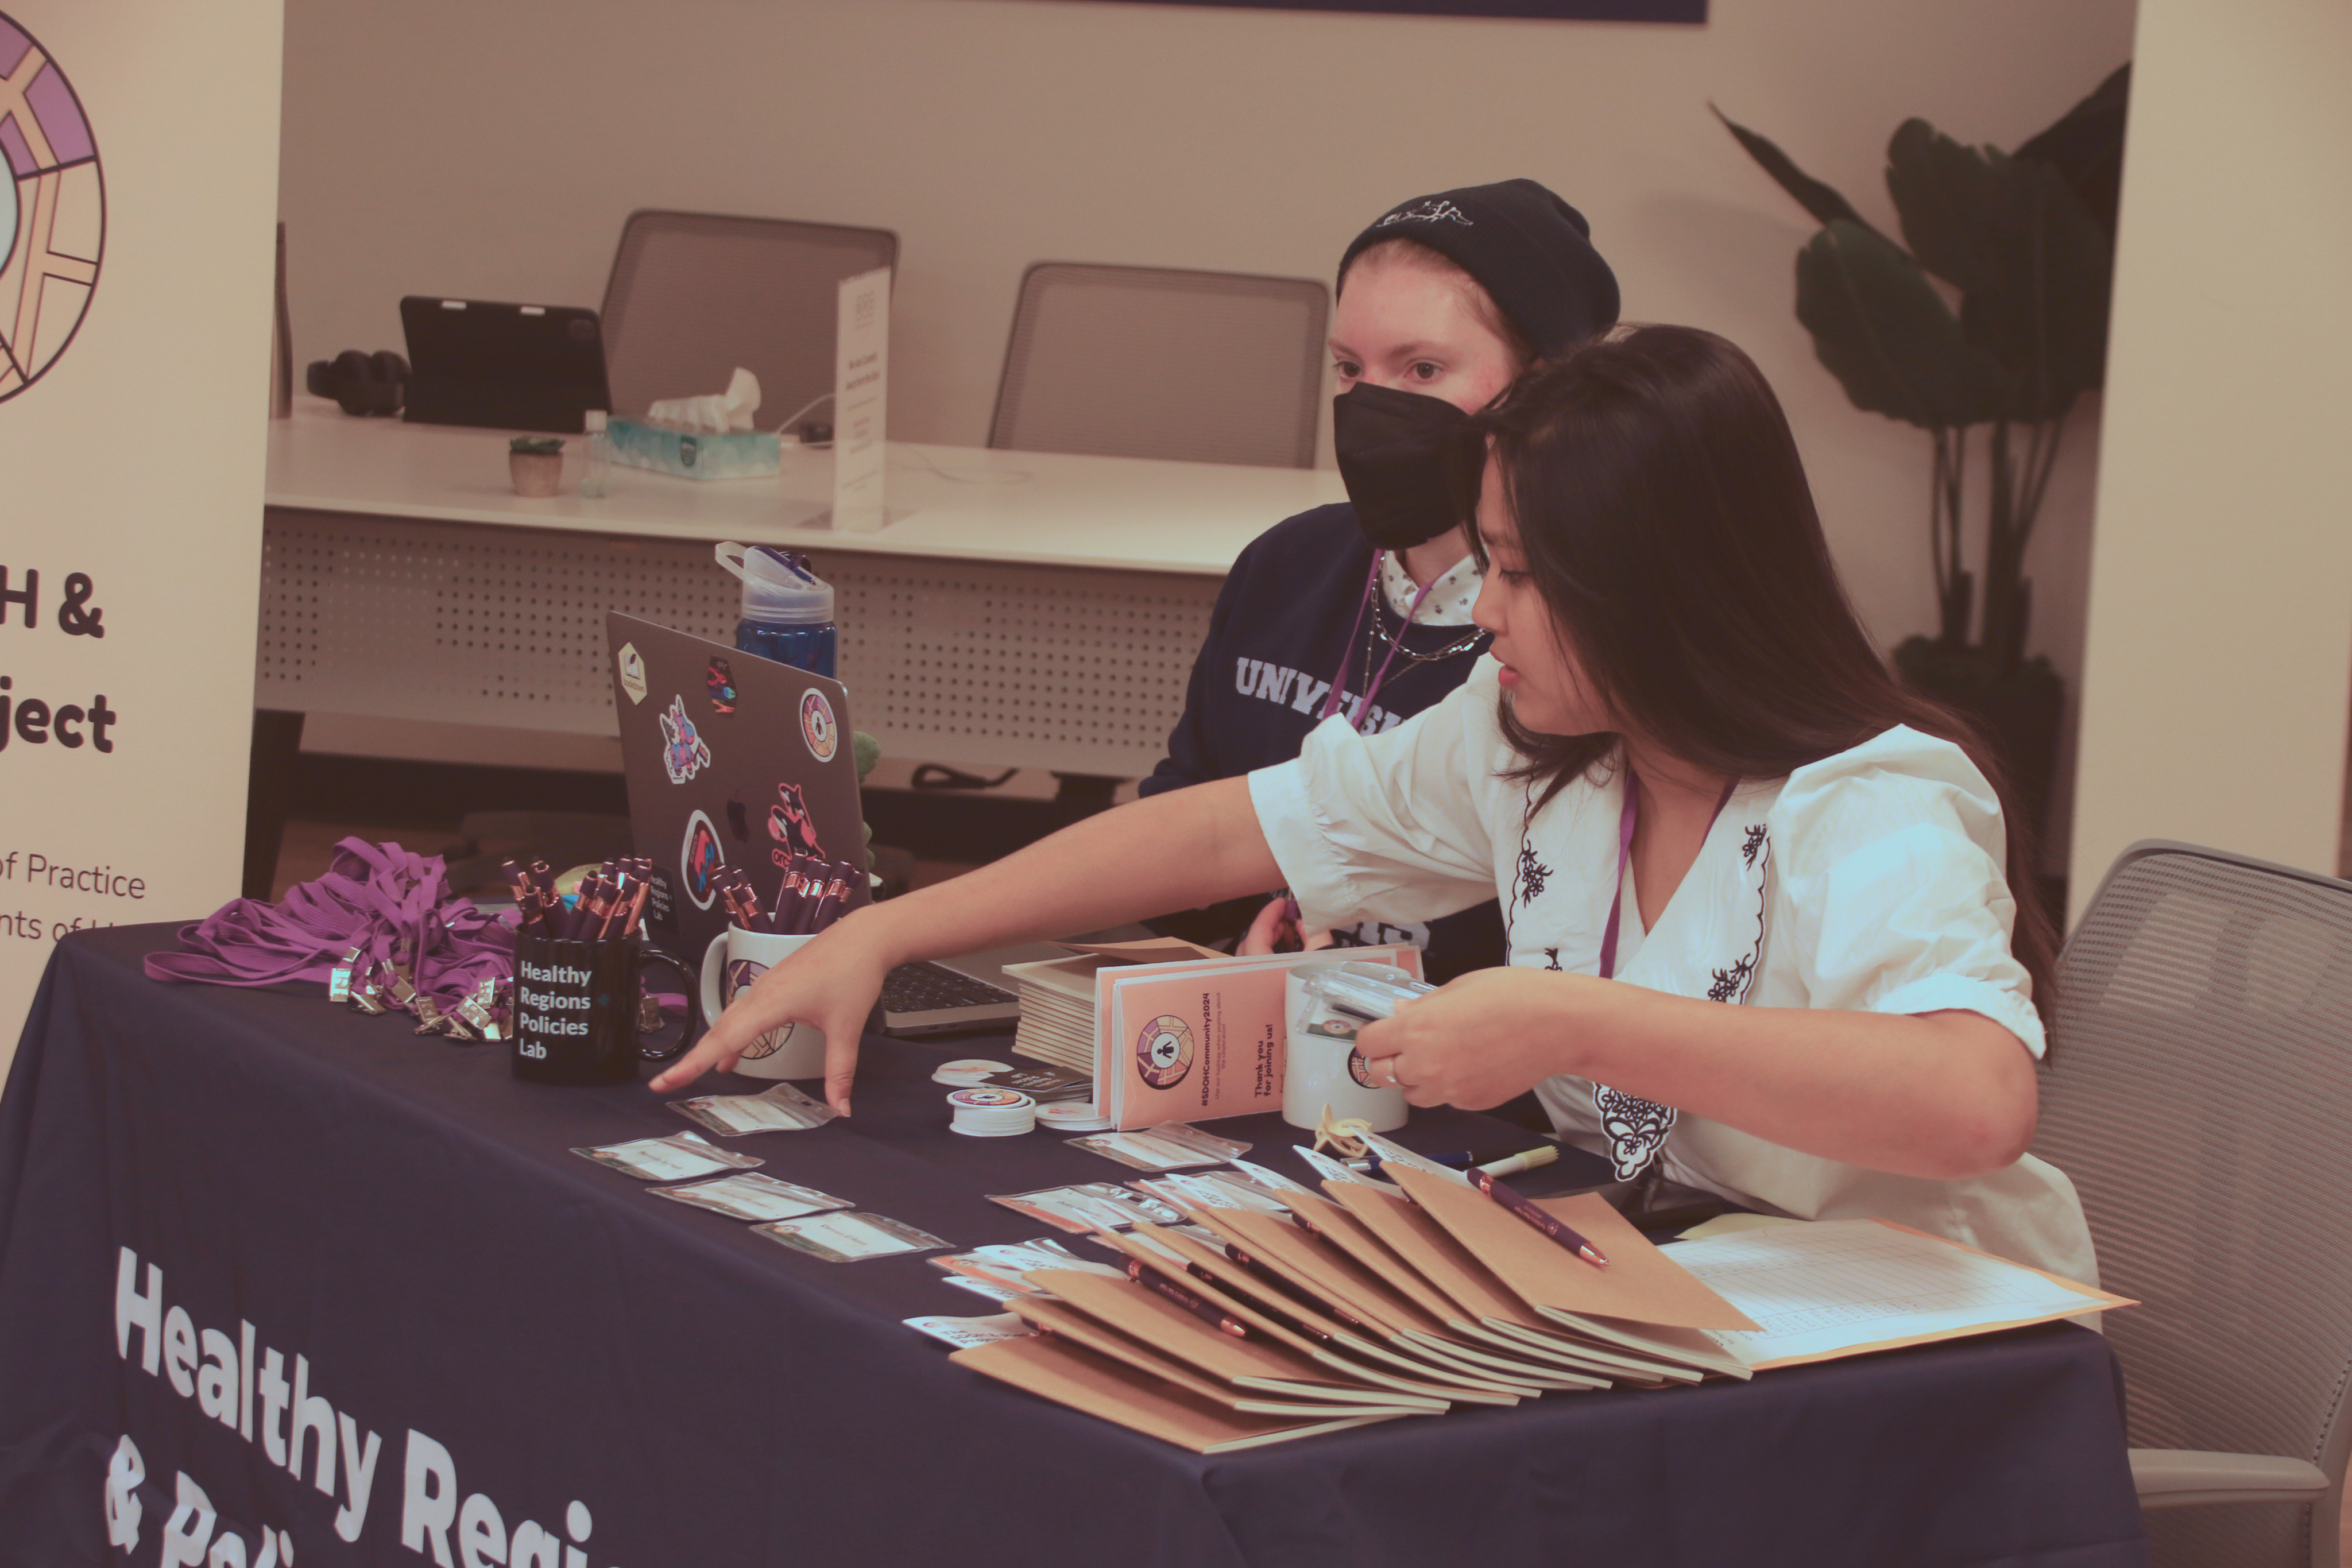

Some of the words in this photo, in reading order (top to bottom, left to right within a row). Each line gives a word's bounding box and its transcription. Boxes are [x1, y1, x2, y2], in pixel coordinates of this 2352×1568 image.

[59, 572, 105, 638] &
[28, 854, 145, 899] Practice
[521, 961, 592, 987] Healthy
[521, 986, 591, 1011] Regions
[520, 1012, 589, 1035] Policies
[1264, 1024, 1272, 1039] us!
[520, 1038, 547, 1059] Lab
[1201, 993, 1212, 1106] #SDOHCommunity2024
[1257, 1040, 1266, 1061] you
[1264, 1042, 1274, 1078] joining
[1255, 1064, 1263, 1098] Thank
[1263, 1081, 1272, 1097] for
[117, 1246, 382, 1542] Healthy
[105, 1434, 146, 1555] &
